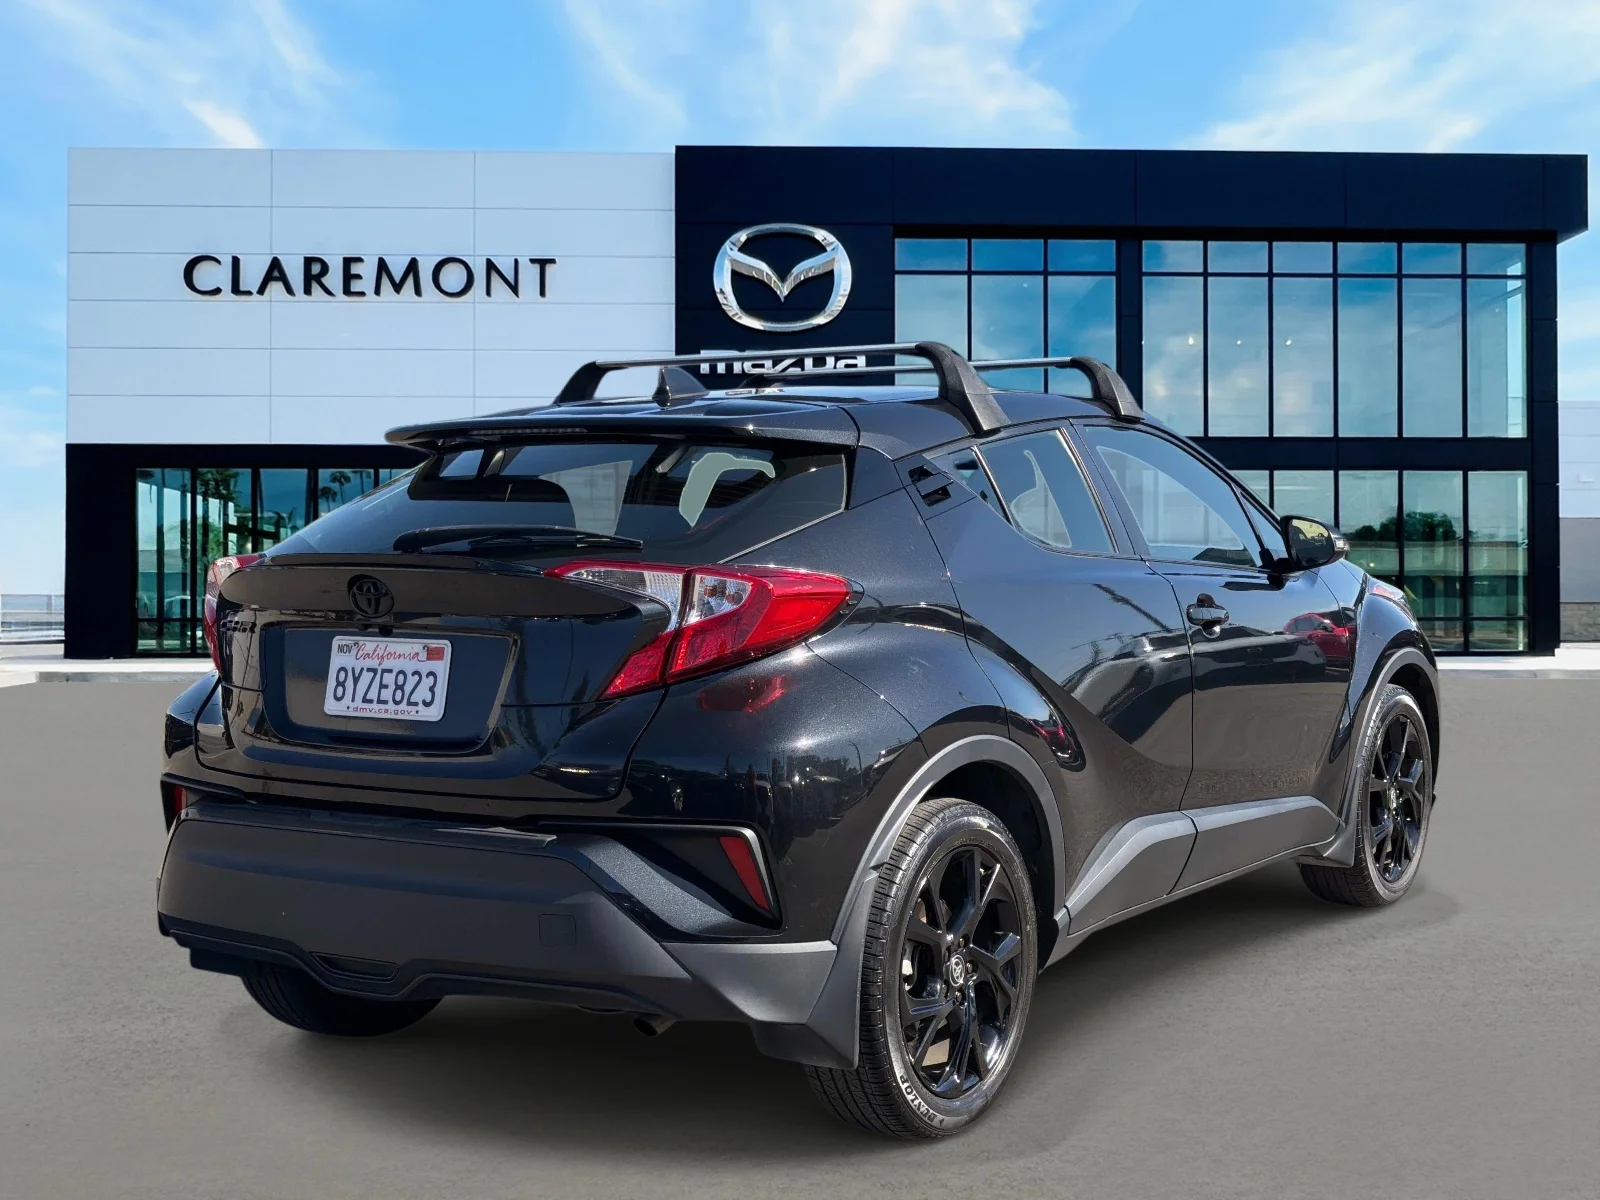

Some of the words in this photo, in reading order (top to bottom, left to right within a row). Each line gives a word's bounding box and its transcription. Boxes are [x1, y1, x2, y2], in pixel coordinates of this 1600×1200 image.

[183, 254, 558, 298] CLAREMONT
[337, 643, 353, 655] NOV
[355, 642, 420, 667] California
[333, 666, 438, 708] 8YZE823
[352, 705, 413, 715] dmv.ca.gov
[899, 1074, 938, 1123] DUNLOP
